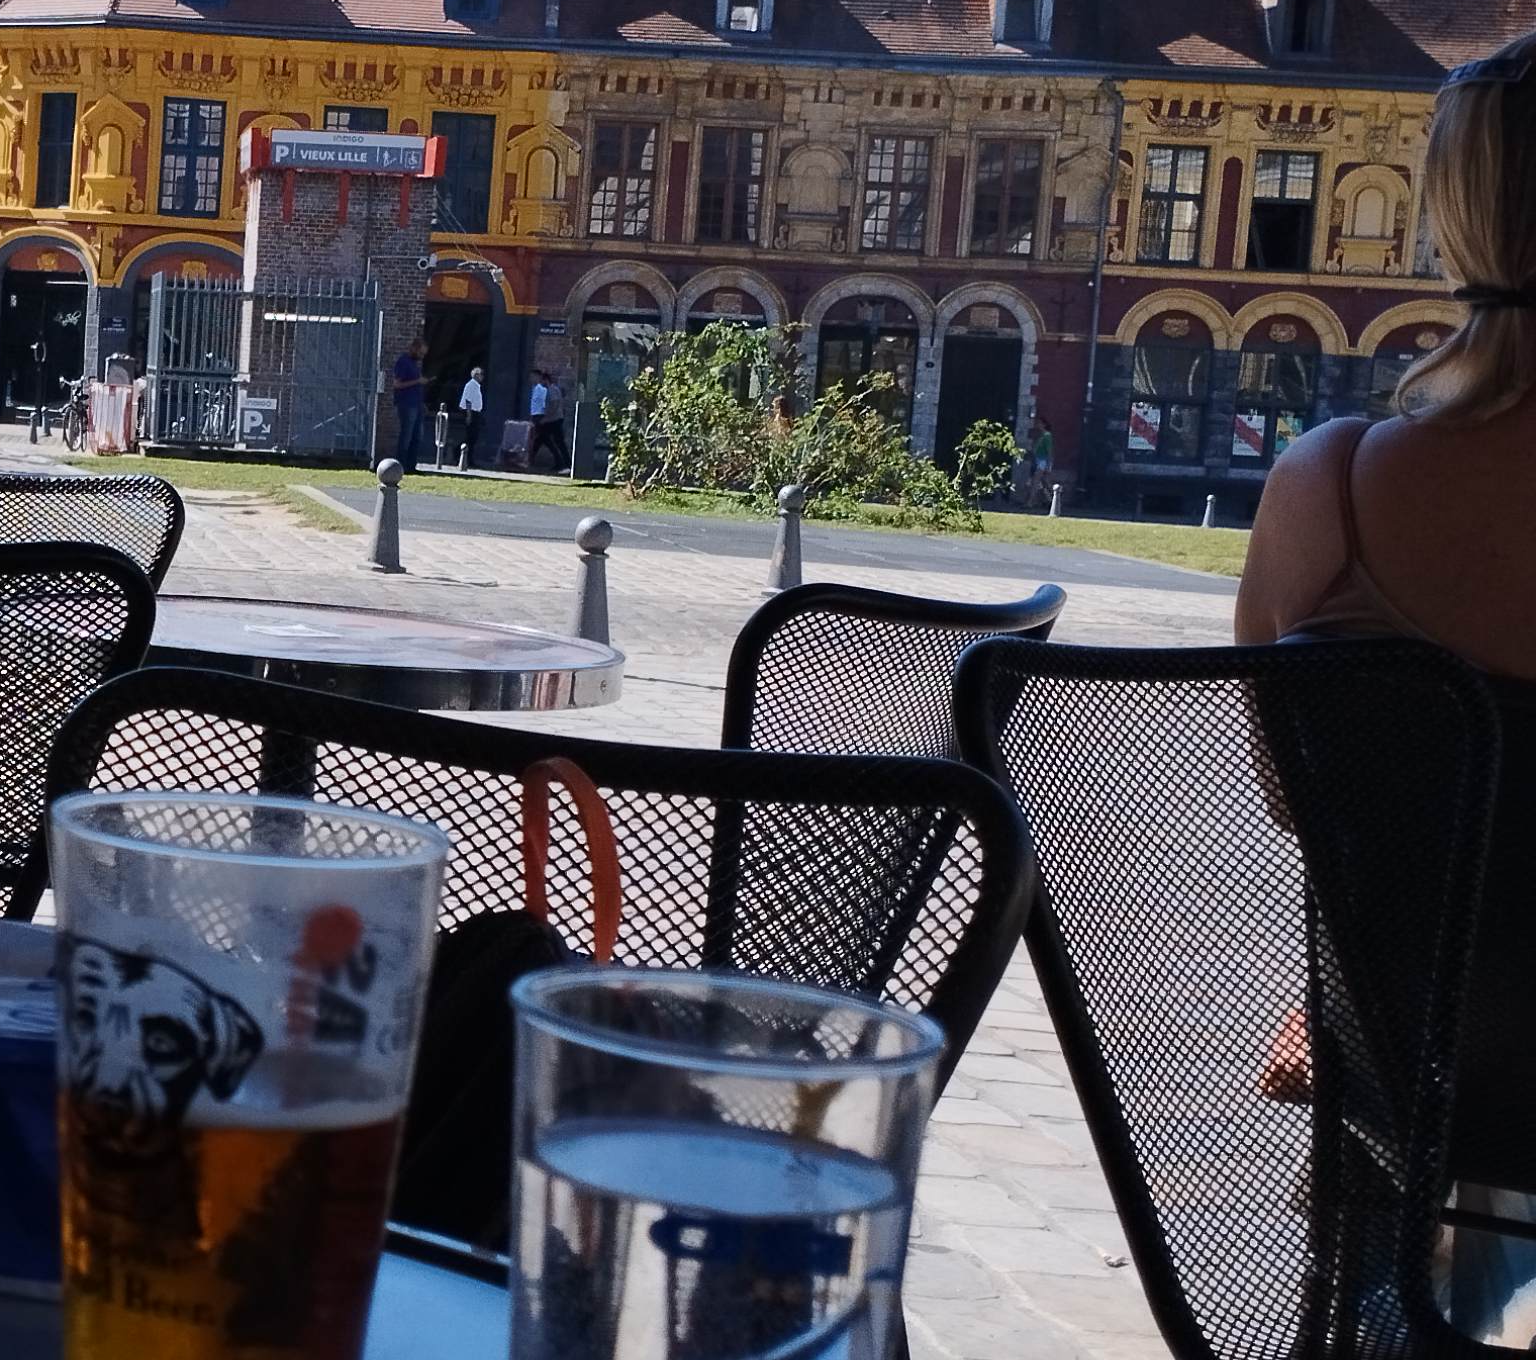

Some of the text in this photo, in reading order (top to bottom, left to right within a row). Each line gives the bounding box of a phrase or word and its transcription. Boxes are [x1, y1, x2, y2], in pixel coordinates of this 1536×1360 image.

[275, 144, 367, 164] P VIEUX LILLE
[243, 410, 263, 434] P
